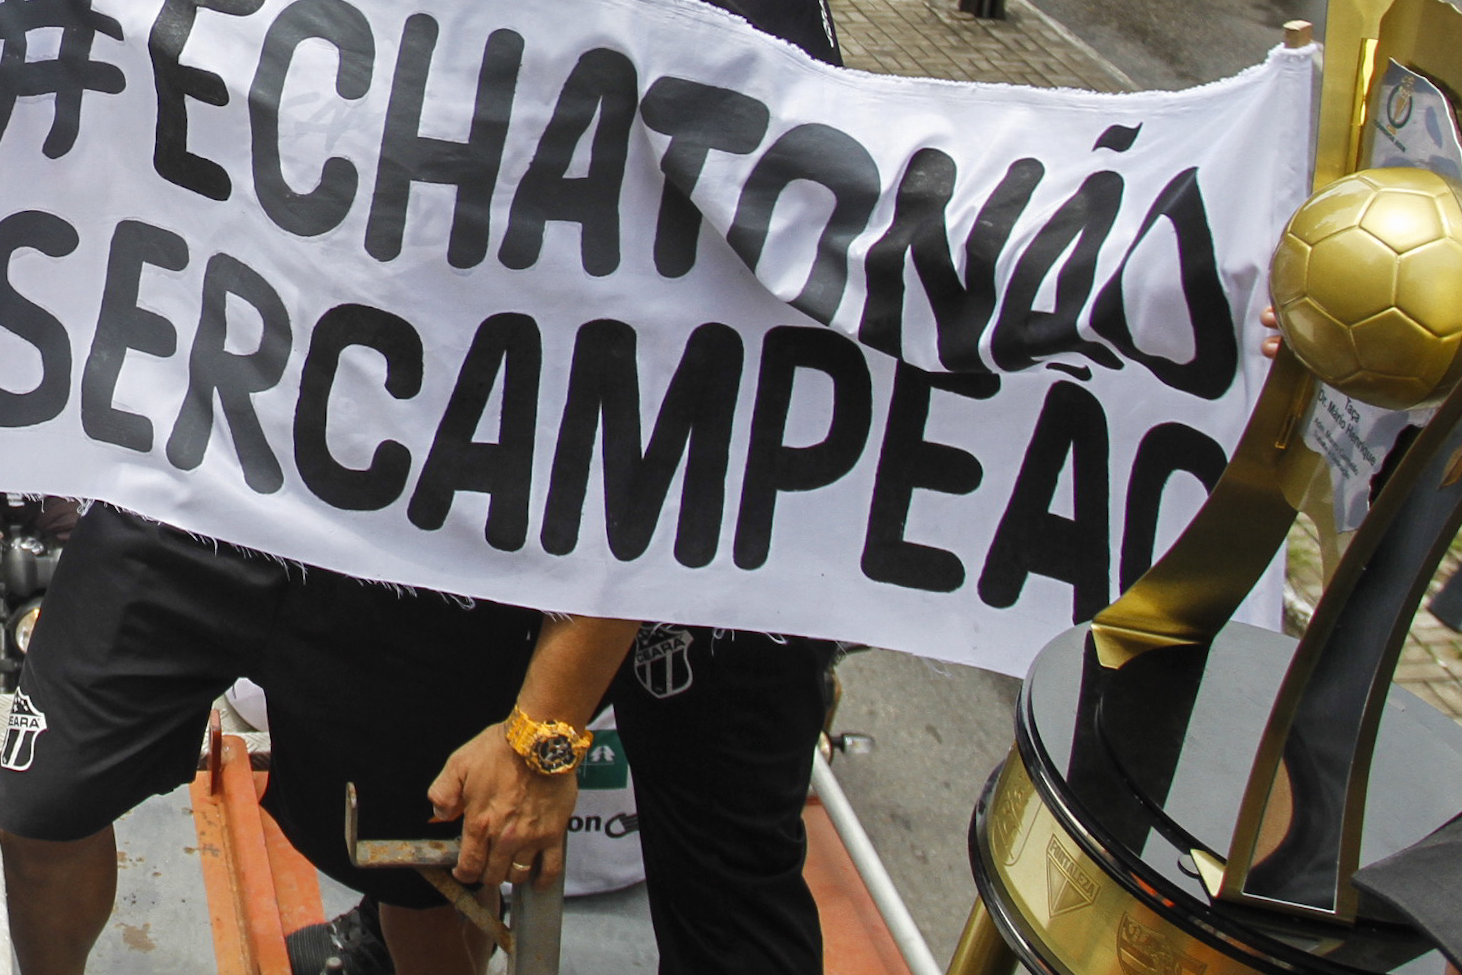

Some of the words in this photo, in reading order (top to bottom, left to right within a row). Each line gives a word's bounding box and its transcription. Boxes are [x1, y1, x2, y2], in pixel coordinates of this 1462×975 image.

[1344, 397, 1361, 424] Taça
[1345, 423, 1377, 467] Henrique
[1049, 841, 1096, 897] FORTALEZA
